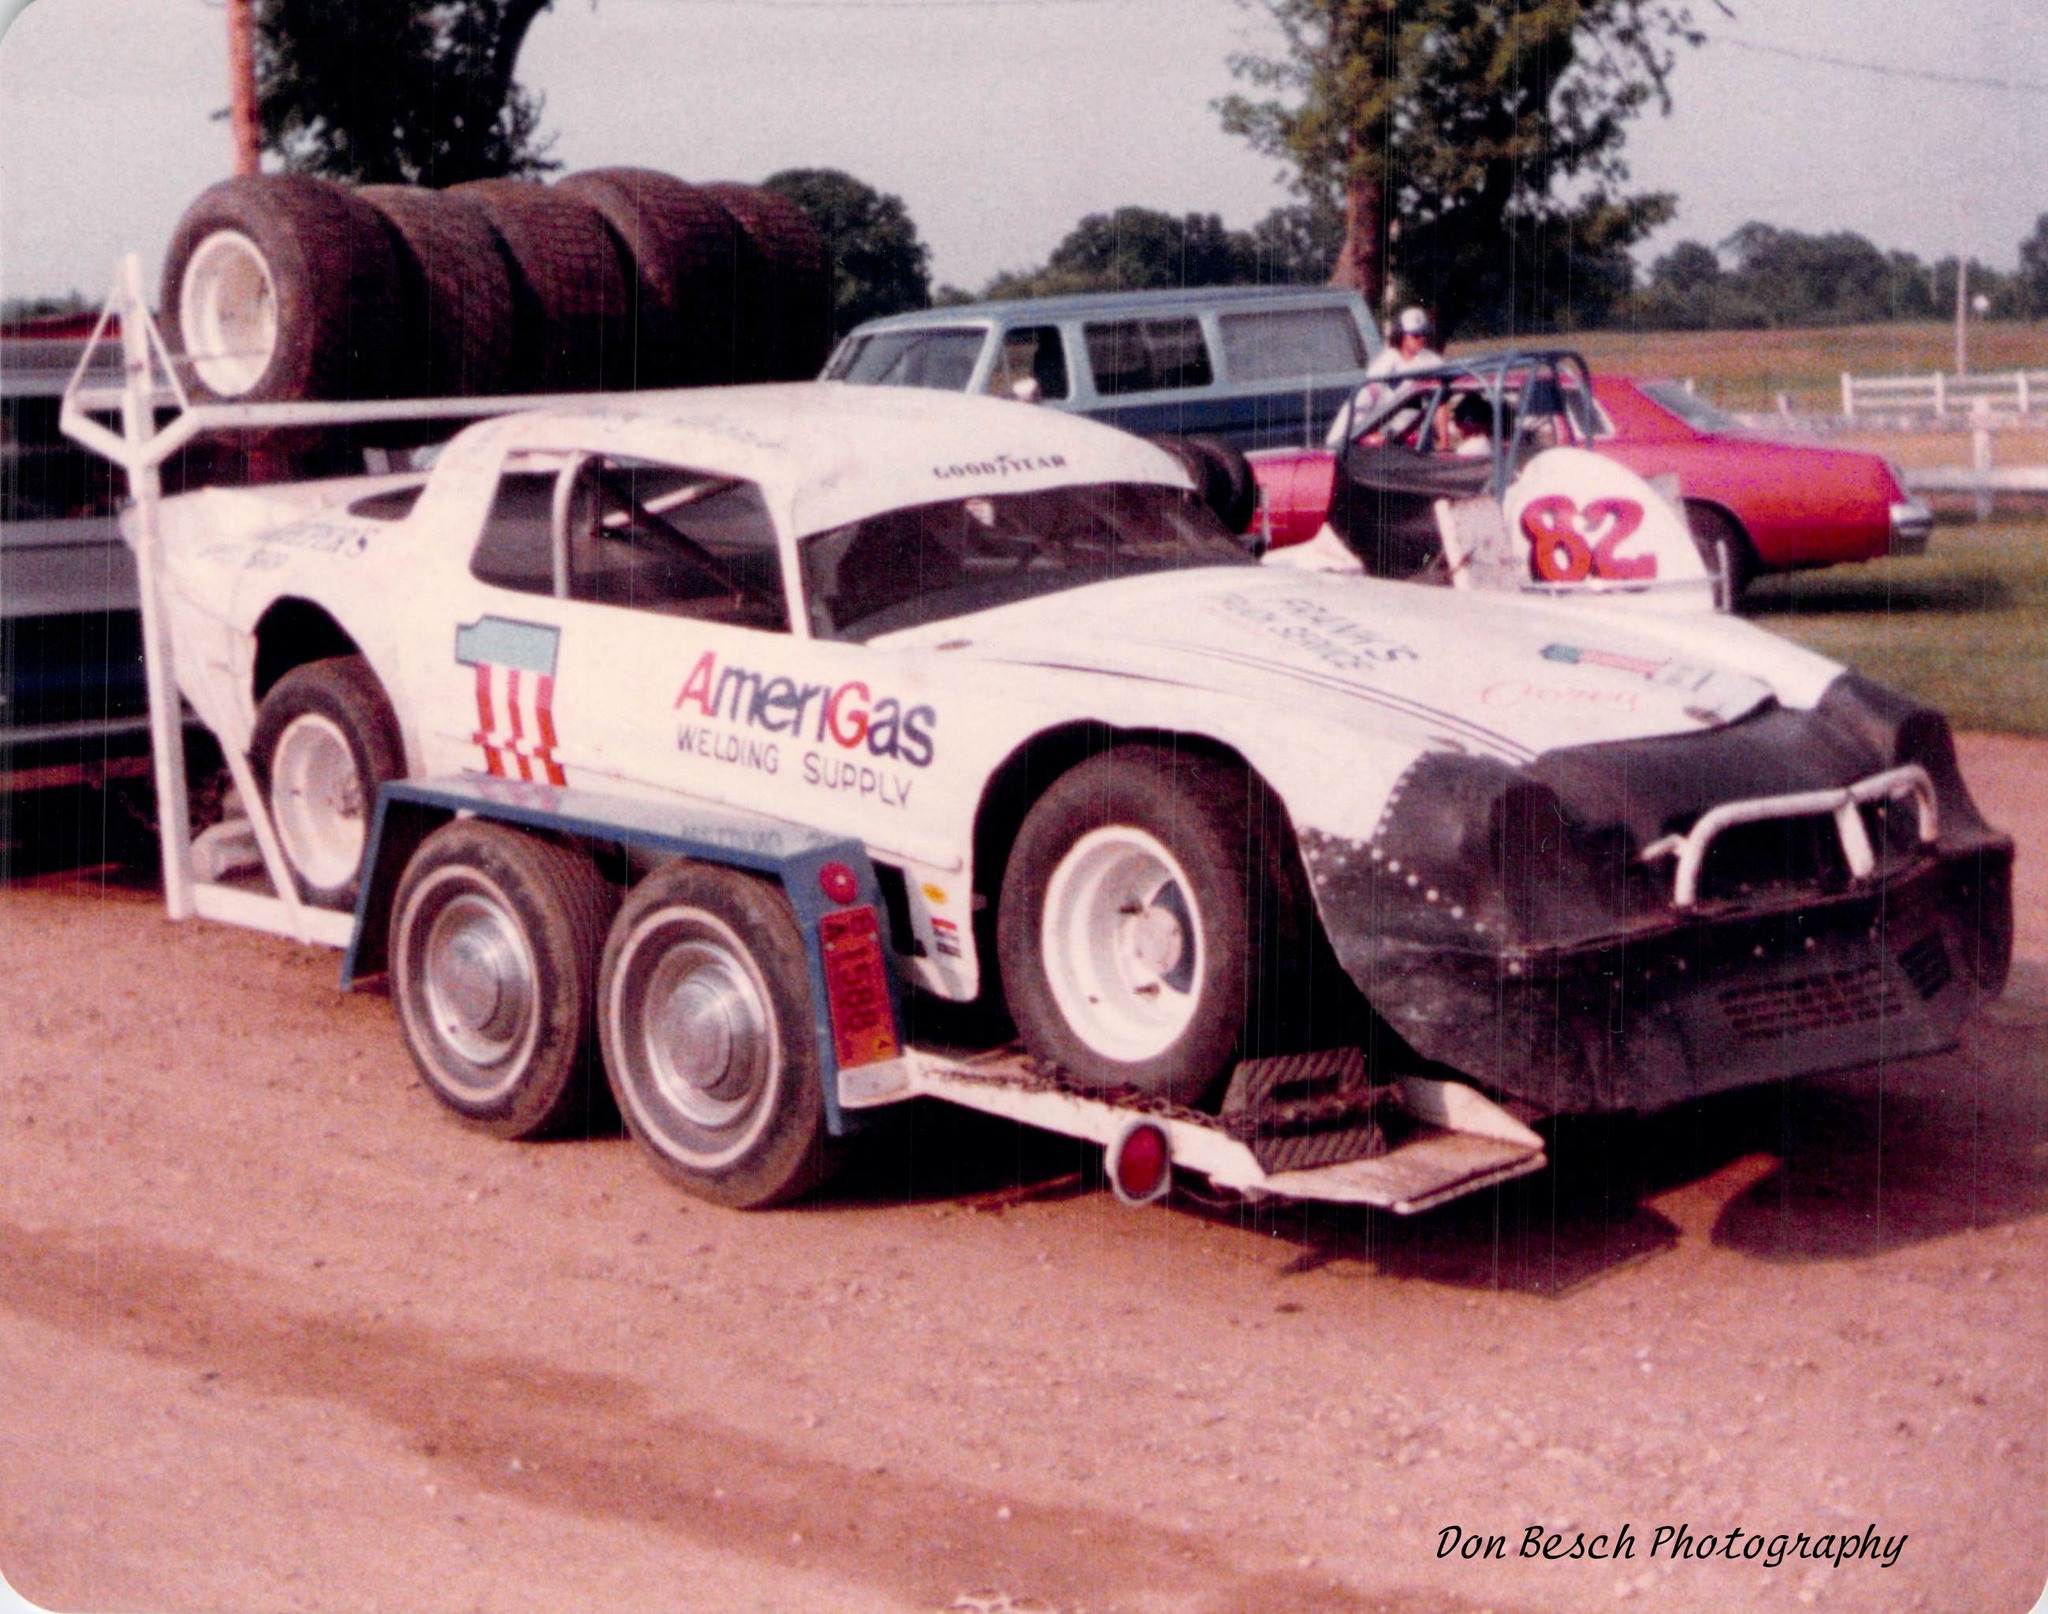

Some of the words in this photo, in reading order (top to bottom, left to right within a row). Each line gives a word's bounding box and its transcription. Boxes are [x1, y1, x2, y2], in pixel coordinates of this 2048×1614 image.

[933, 454, 1067, 479] GOODYEAR
[1520, 495, 1657, 582] 82
[675, 650, 937, 768] AmeriGas
[676, 722, 780, 775] WELDING
[803, 752, 912, 808] SUPPLY
